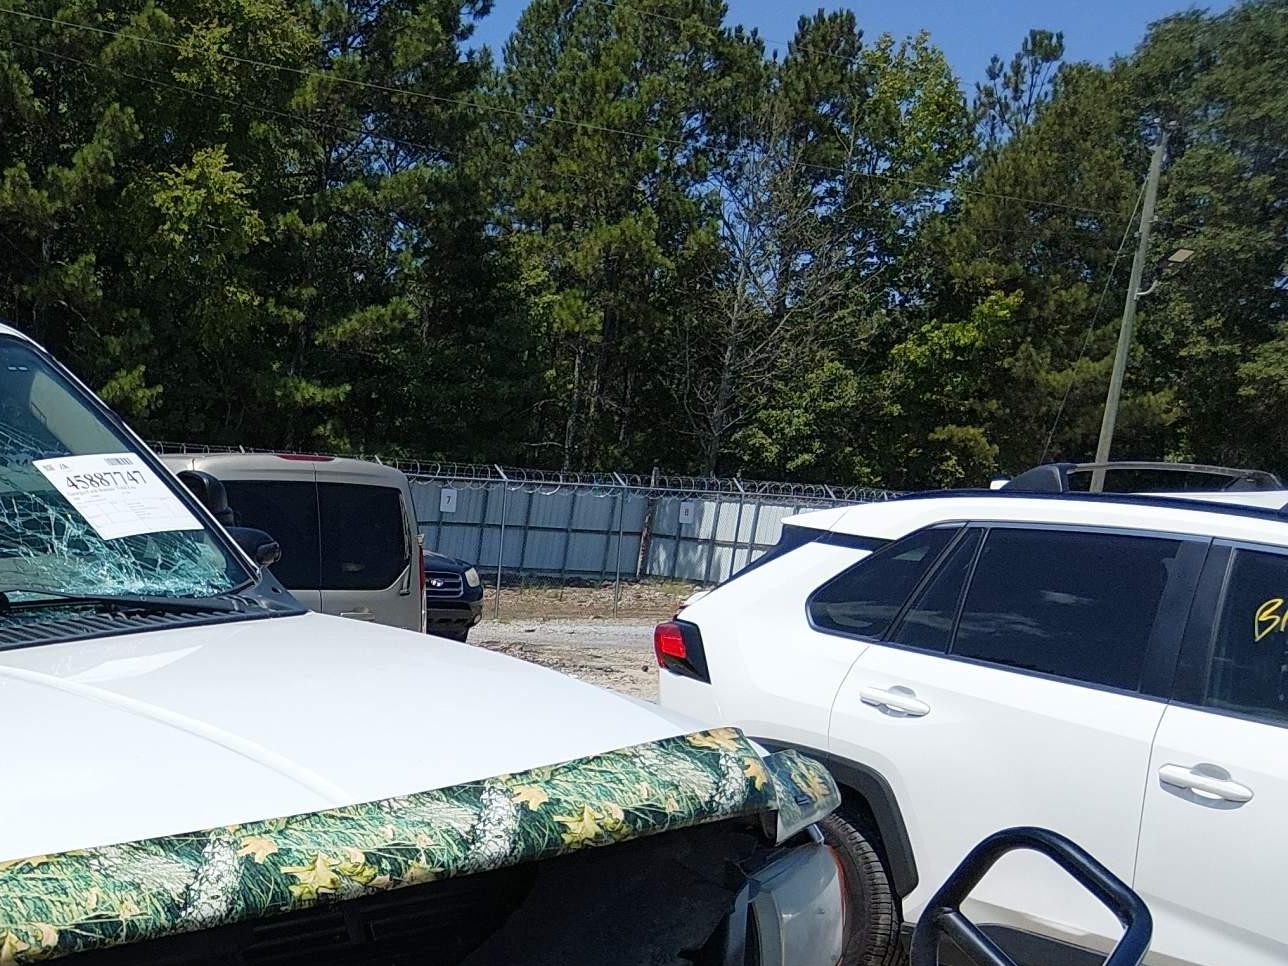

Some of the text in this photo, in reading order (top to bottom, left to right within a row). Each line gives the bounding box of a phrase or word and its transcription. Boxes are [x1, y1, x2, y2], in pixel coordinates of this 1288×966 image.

[66, 470, 148, 490] 45887747
[446, 495, 452, 505] 7
[1253, 598, 1288, 642] B
